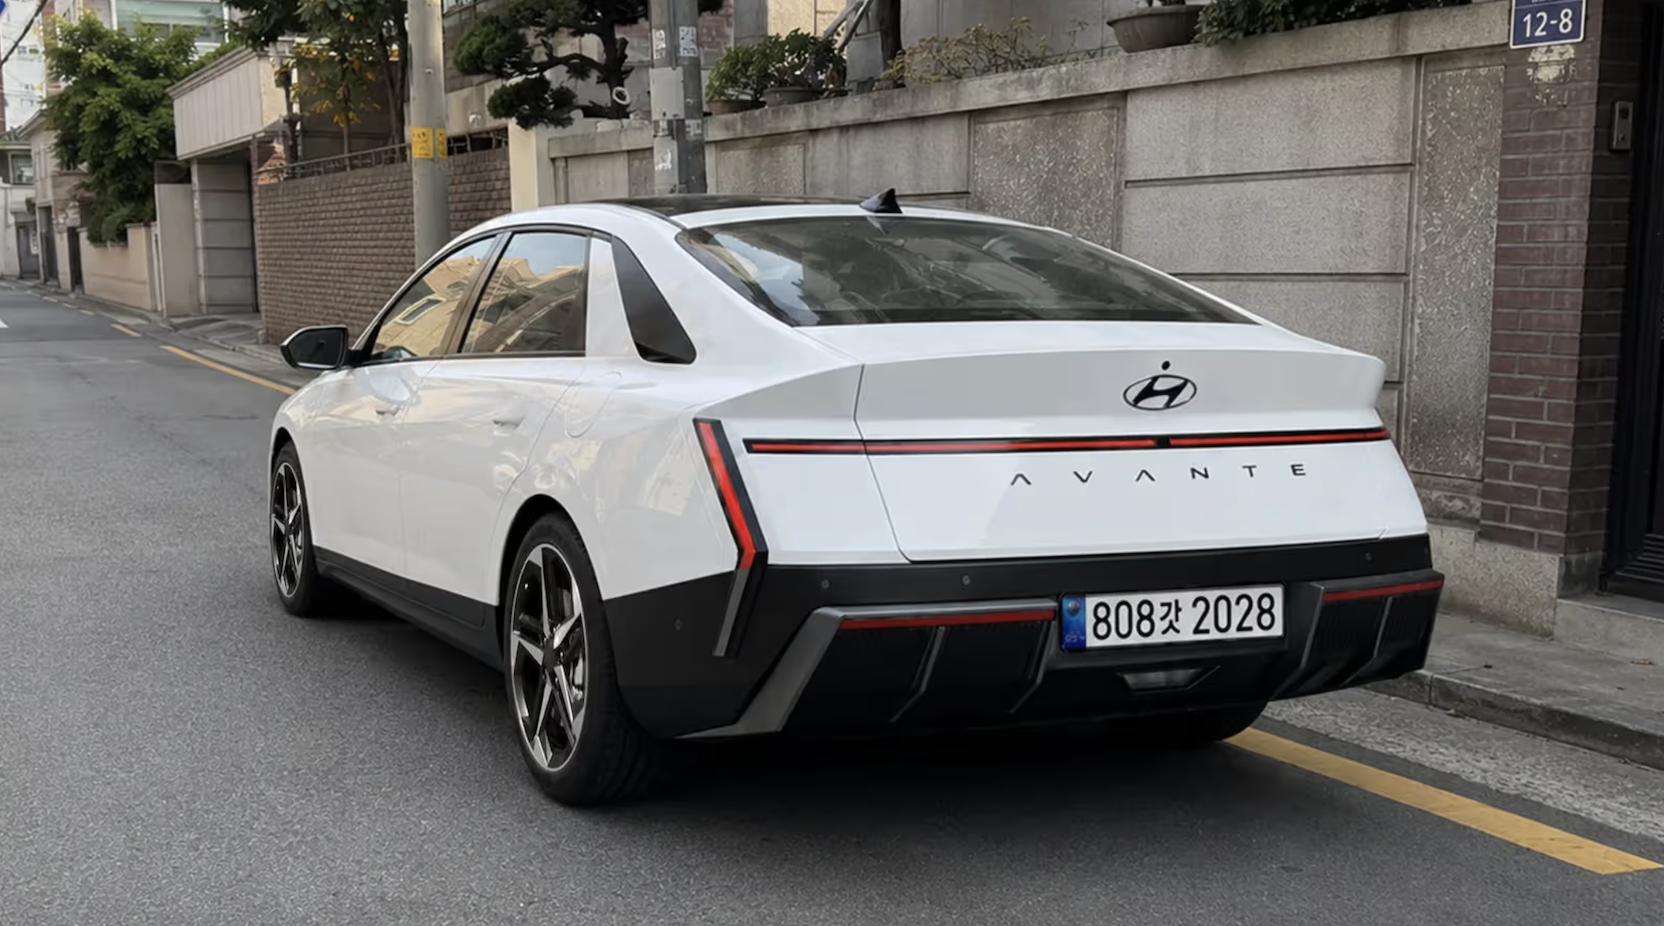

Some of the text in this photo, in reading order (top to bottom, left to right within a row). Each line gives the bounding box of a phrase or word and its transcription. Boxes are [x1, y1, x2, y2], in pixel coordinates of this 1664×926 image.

[1523, 8, 1573, 38] 12-8
[1010, 463, 1306, 486] AVANTE
[1092, 592, 1276, 641] 808갓 2028
